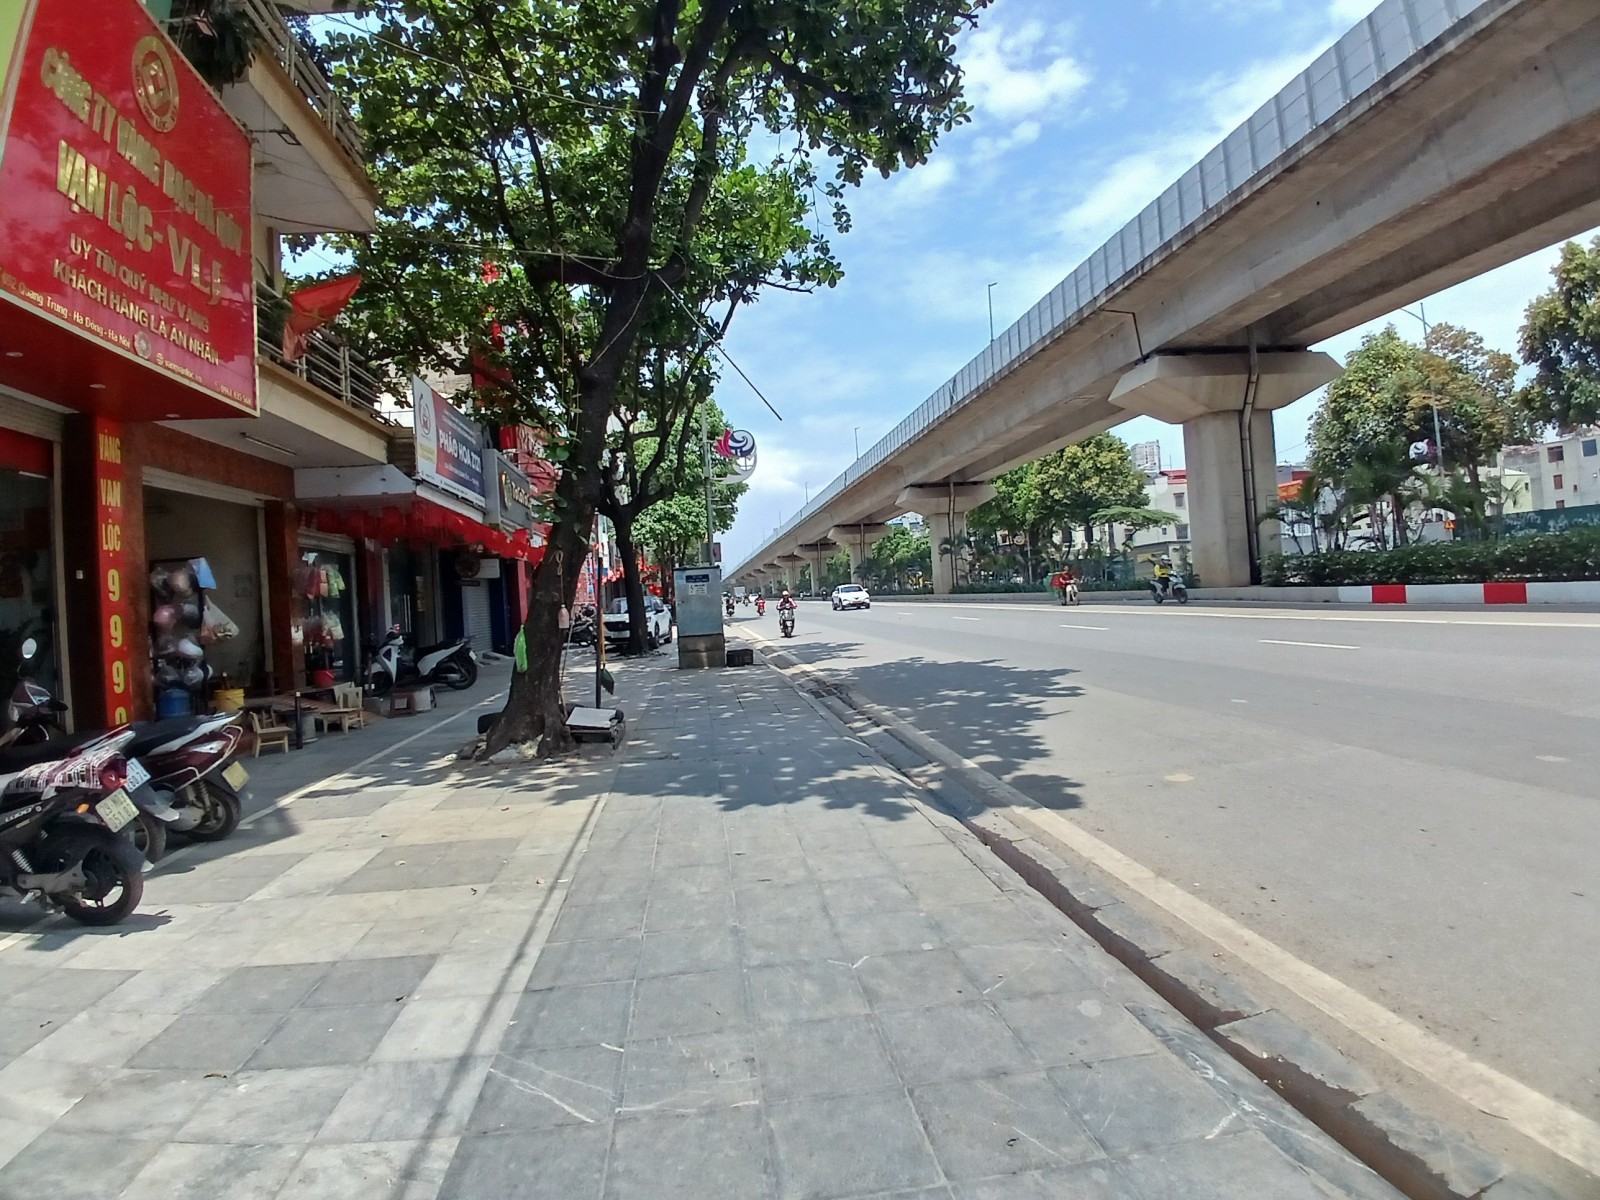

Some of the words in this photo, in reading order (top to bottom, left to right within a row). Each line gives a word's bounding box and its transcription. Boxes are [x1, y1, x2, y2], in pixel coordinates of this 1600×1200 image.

[92, 91, 117, 144] TY
[57, 139, 107, 220] VẠN
[69, 232, 92, 260] UY
[119, 265, 148, 294] QUÝ
[19, 281, 44, 306] Quang
[46, 296, 68, 319] Trung
[53, 258, 108, 306] KHÁCH
[110, 291, 149, 328] HÀNG
[150, 314, 168, 339] LÀ
[170, 323, 188, 349] ÂN
[98, 428, 121, 464] VÀNG
[100, 478, 121, 513] VẠN
[102, 518, 121, 557] LỘC
